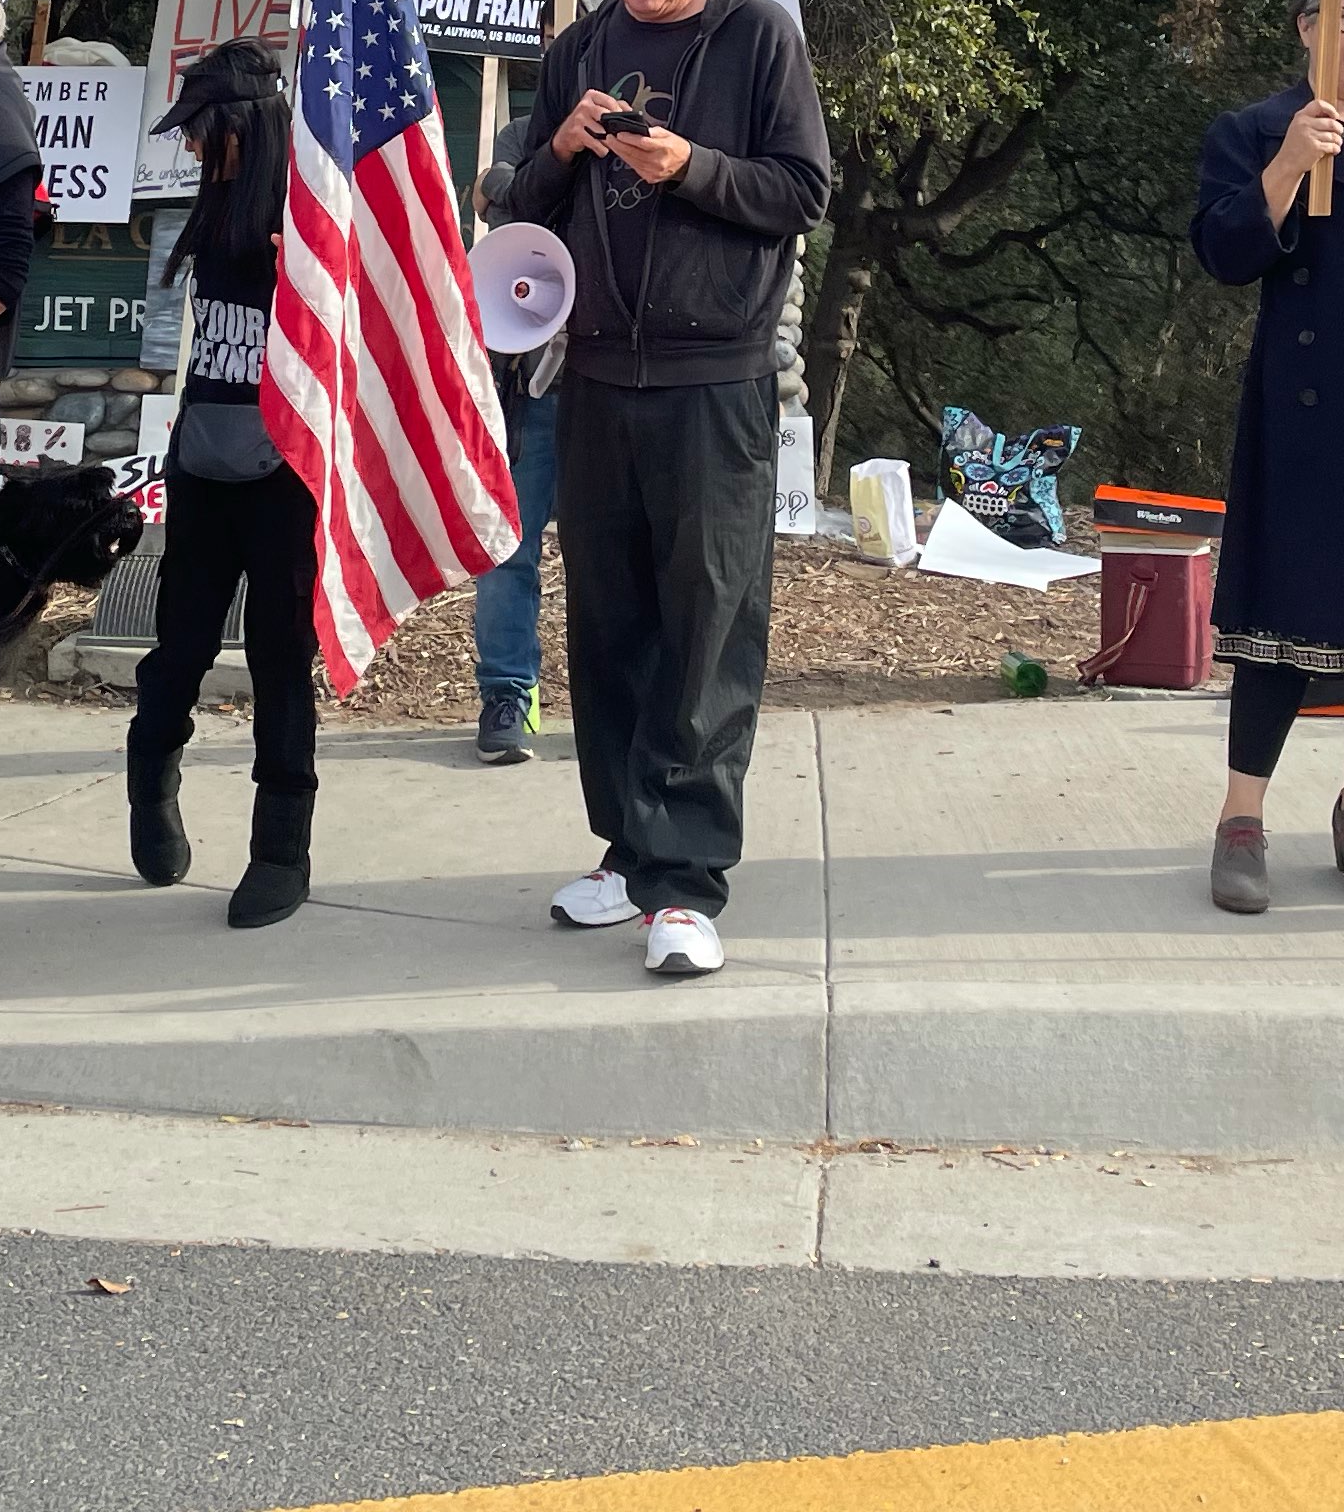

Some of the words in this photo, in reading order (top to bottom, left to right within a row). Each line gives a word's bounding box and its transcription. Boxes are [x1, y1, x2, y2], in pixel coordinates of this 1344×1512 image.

[444, 26, 487, 42] AUTHOR,
[489, 31, 503, 42] US
[42, 164, 109, 199] ESS
[34, 296, 95, 331] JET
[193, 298, 267, 347] YOUR
